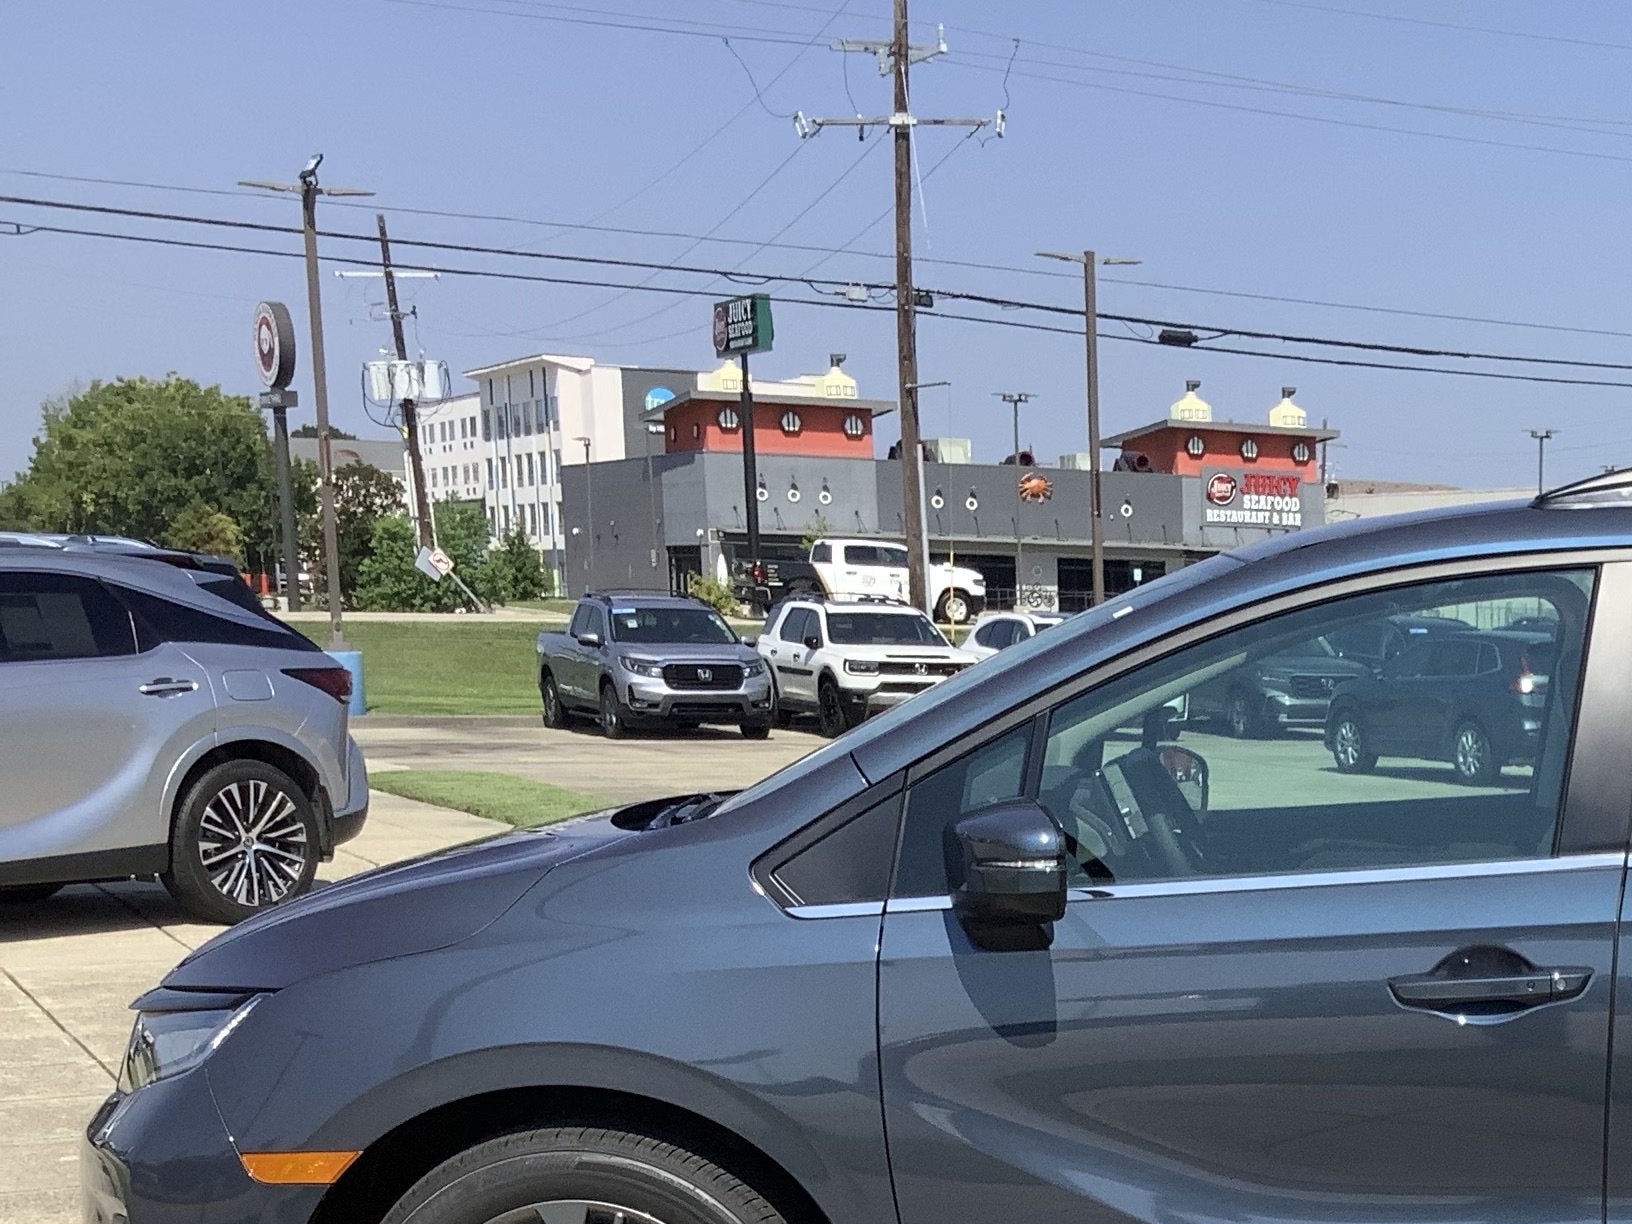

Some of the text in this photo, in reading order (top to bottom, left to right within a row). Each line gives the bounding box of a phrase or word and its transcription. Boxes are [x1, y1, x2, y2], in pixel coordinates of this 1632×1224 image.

[728, 298, 752, 324] JUICY
[728, 320, 753, 339] SEAFOOD
[1240, 473, 1300, 496] JUICY
[1243, 494, 1300, 512] SEAFOOD
[1206, 508, 1302, 526] RESTAURANT & BAR
